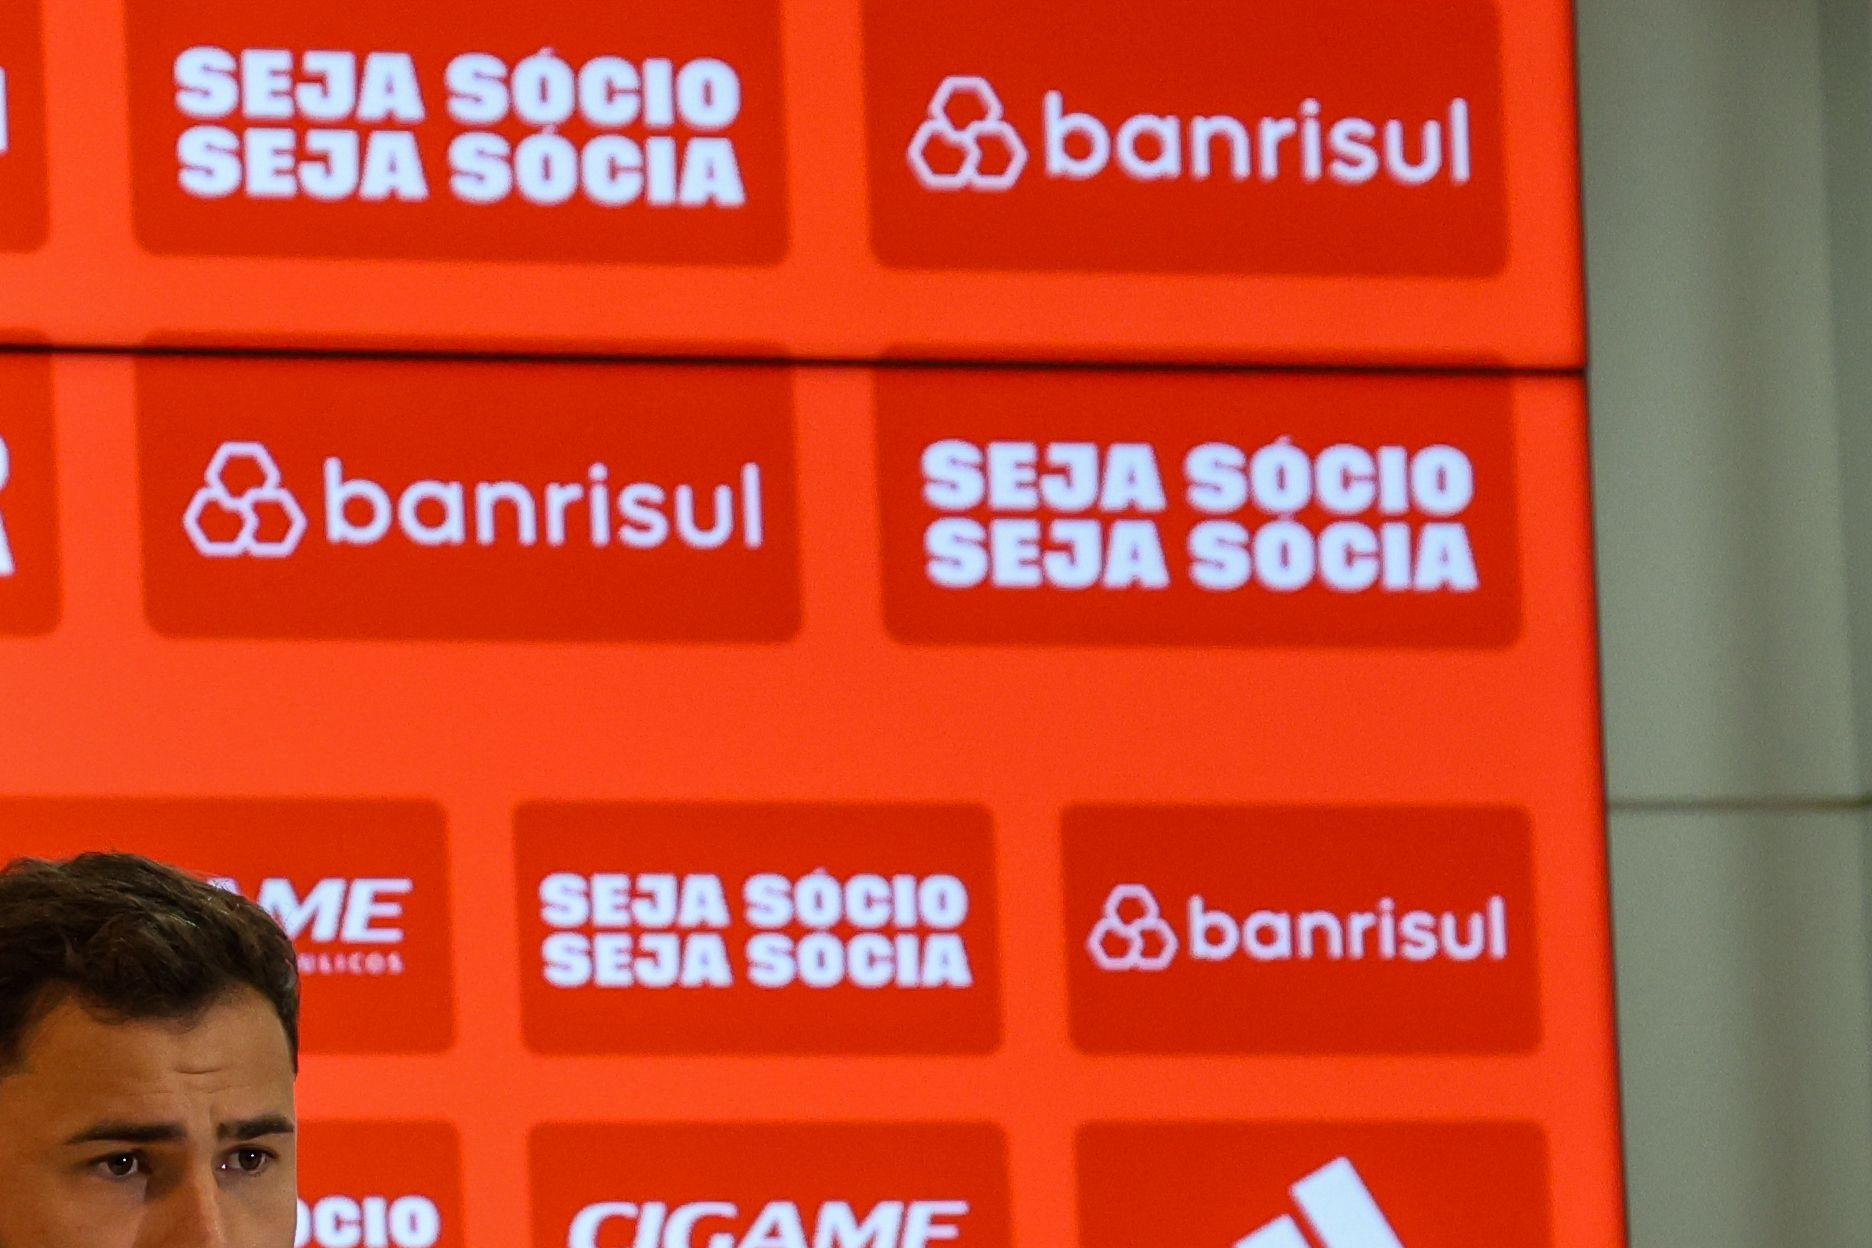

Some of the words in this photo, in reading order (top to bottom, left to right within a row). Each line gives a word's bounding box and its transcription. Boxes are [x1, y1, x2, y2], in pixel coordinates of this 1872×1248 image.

[174, 46, 425, 123] SEJA
[445, 48, 740, 129] SÓCIO
[177, 126, 428, 201] SEJA
[448, 125, 745, 207] SÓCIA
[1044, 91, 1469, 184] banrisul
[324, 457, 763, 548] banrisul
[921, 440, 1167, 512] SEJA
[1184, 436, 1473, 515] SÓCIO
[924, 517, 1170, 589] SEJA
[1188, 512, 1479, 592] SÓCIA
[539, 873, 730, 928] SEJA
[743, 868, 968, 930] SÓCIO
[1189, 896, 1506, 960] banrisul
[542, 932, 733, 987] SEJA
[746, 927, 972, 988] SÓCIA
